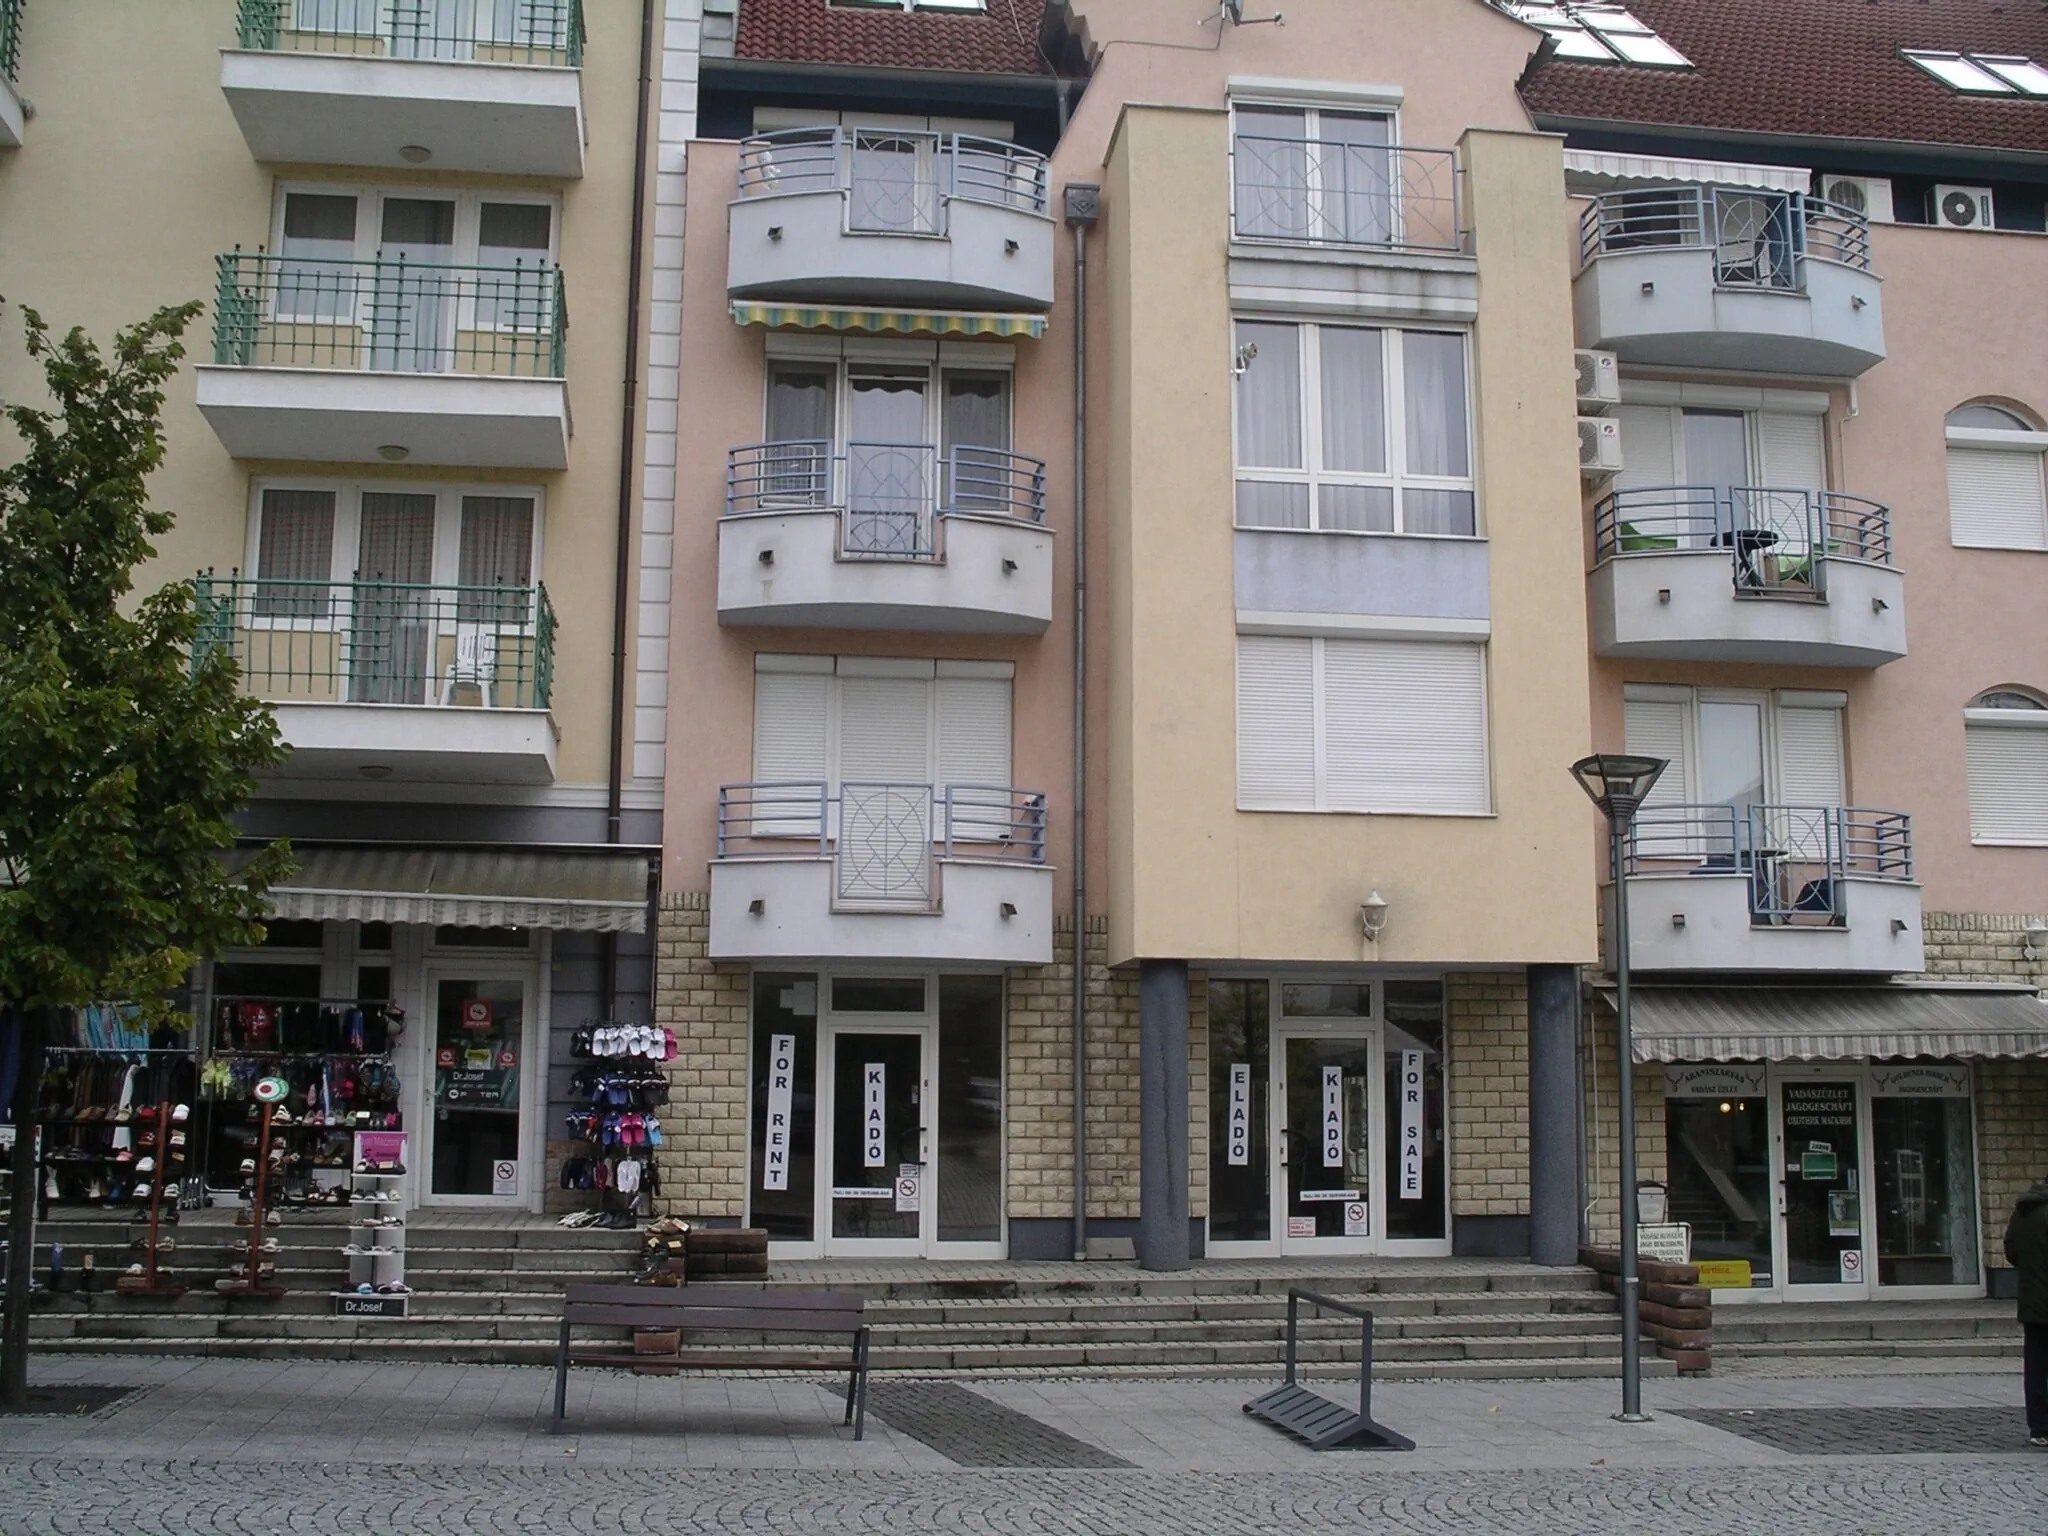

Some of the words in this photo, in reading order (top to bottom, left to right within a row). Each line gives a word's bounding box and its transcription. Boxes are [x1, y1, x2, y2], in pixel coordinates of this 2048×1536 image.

[775, 1039, 790, 1089] FOR
[1406, 1053, 1419, 1103] FOR
[868, 1071, 882, 1159] KIADÓ
[1232, 1071, 1245, 1157] ELADÓ
[1326, 1073, 1340, 1159] KIADÓ
[769, 1113, 785, 1183] RENT
[1405, 1126, 1418, 1190] SALE
[345, 1300, 384, 1313] Dr.Josef
